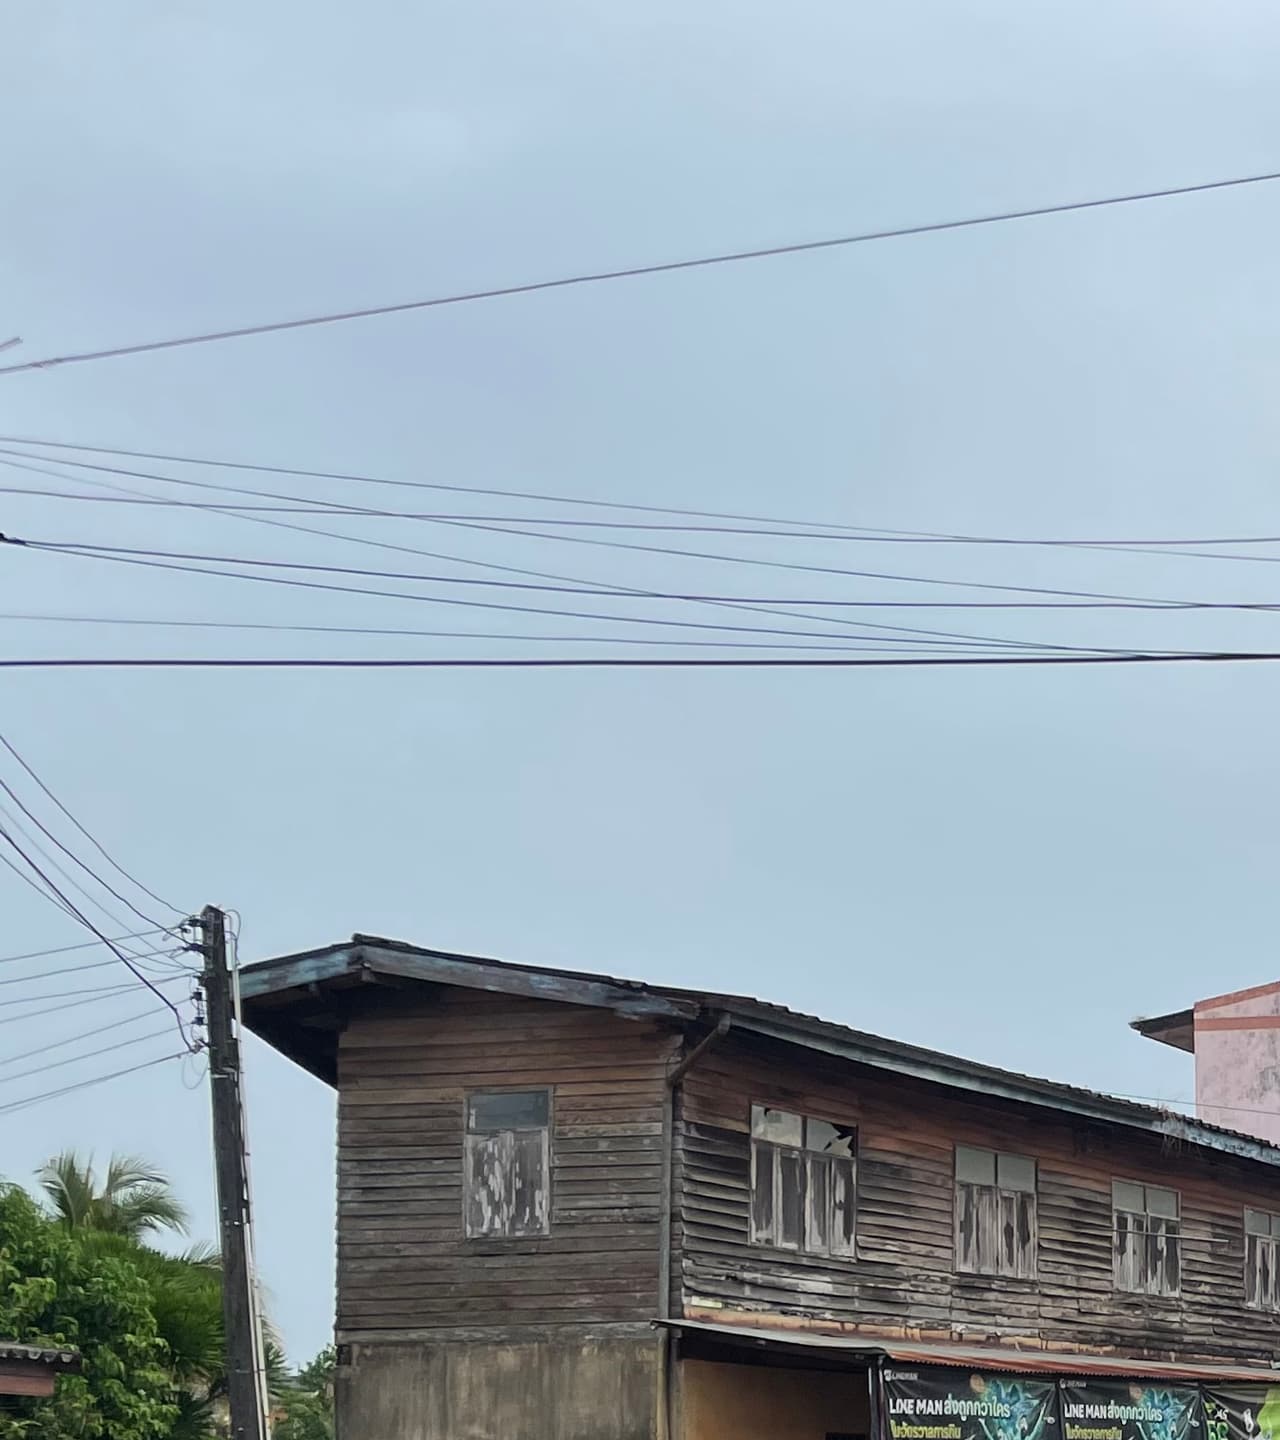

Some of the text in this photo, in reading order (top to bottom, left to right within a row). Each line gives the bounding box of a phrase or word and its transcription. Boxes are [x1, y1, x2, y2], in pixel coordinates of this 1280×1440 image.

[889, 1397, 914, 1415] LINE
[915, 1399, 943, 1416] MAN
[1086, 1404, 1107, 1420] MAN
